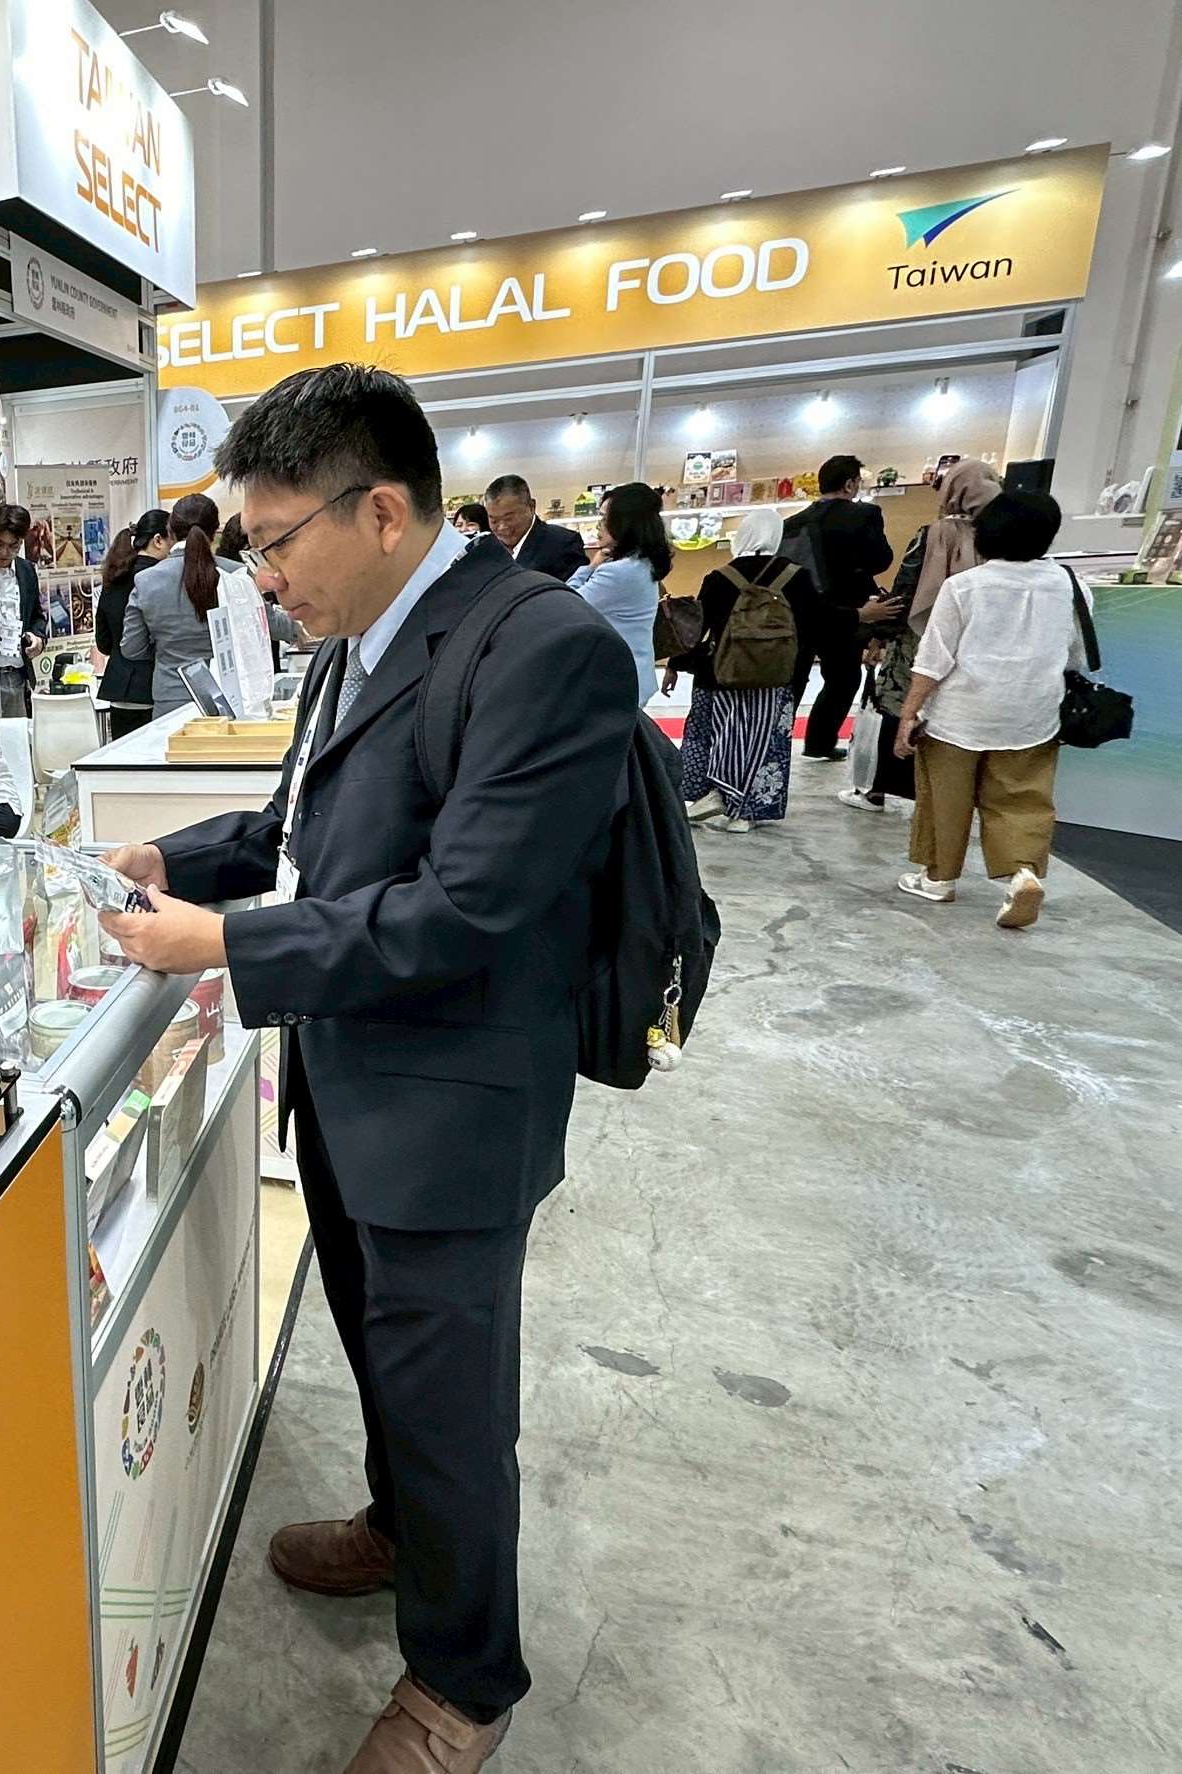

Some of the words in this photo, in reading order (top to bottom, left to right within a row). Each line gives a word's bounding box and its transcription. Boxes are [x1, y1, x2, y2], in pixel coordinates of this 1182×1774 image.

[71, 27, 161, 177] TAAN
[74, 129, 162, 253] SELECT
[365, 273, 571, 343] HALAL
[606, 237, 810, 312] FOOD
[887, 257, 1013, 290] Taiwan
